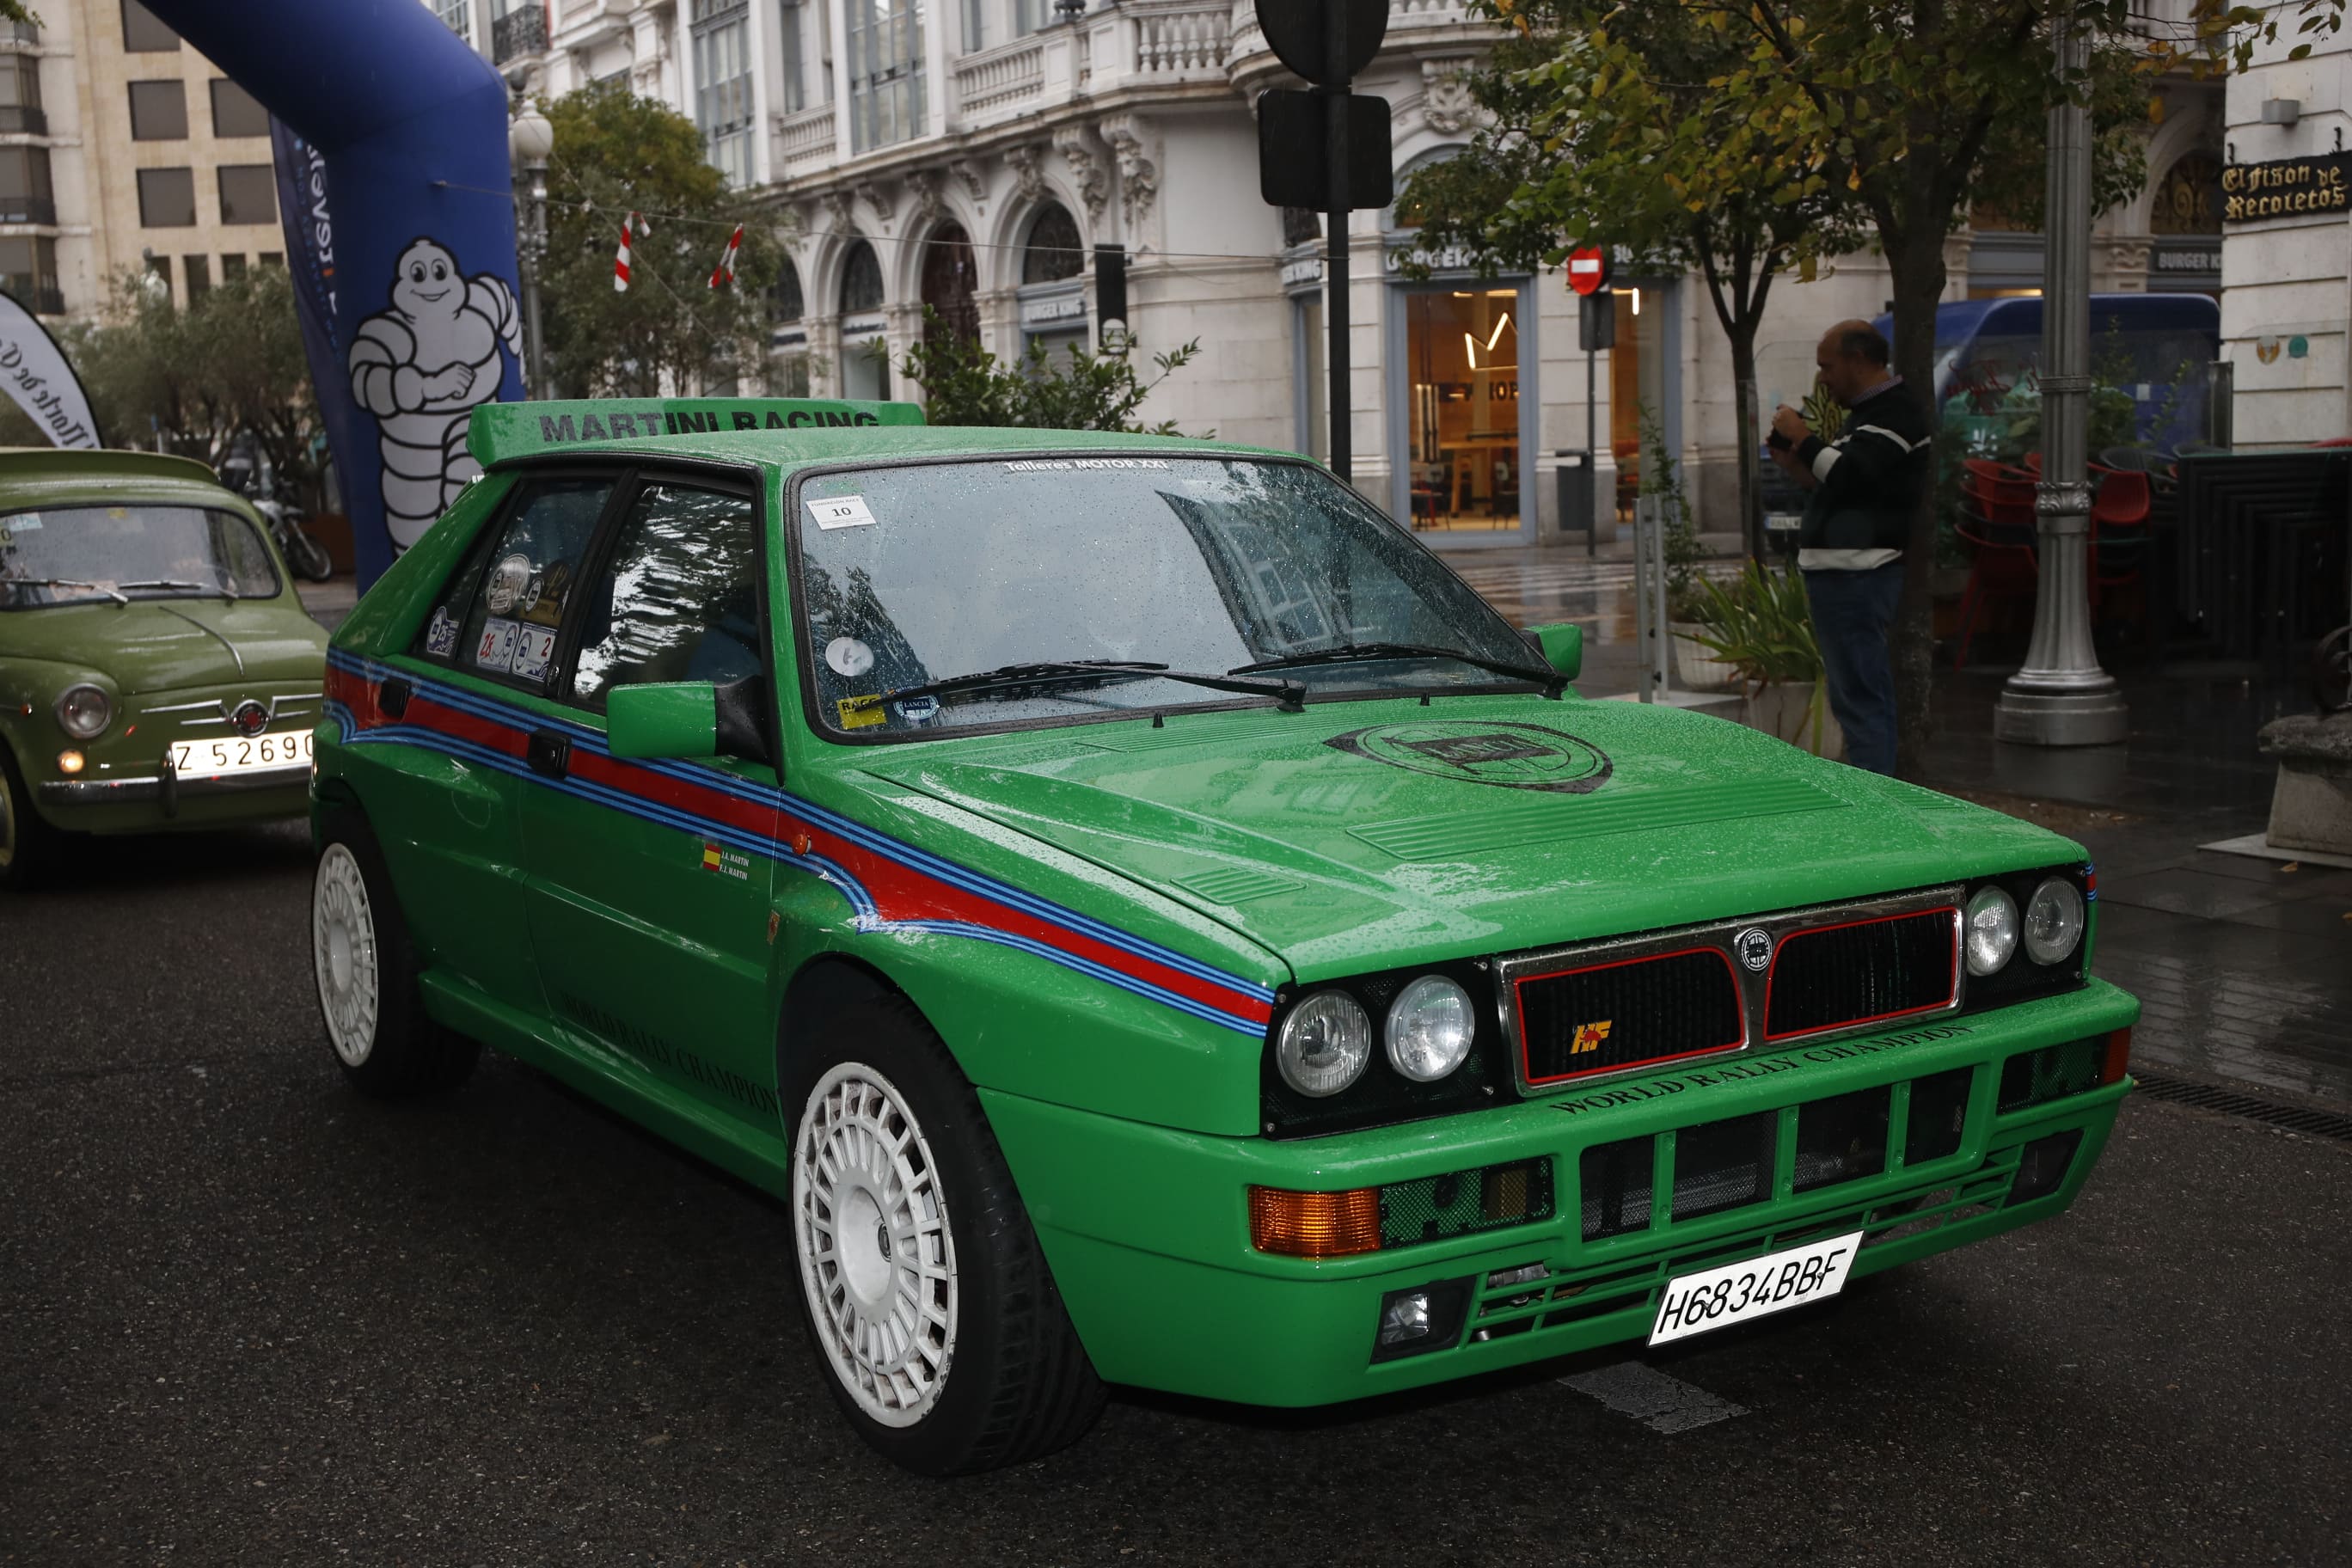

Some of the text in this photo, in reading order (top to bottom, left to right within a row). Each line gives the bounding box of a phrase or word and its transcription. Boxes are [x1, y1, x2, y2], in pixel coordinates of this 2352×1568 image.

[539, 411, 879, 443] MARTINI RACING
[1004, 460, 1073, 472] Talleres
[1075, 460, 1136, 469] MOTOR
[831, 507, 852, 517] 10
[541, 637, 551, 657] 2
[176, 746, 192, 770] Z
[1570, 1020, 1612, 1054] HF
[676, 1048, 779, 1115] CHAMPION
[1551, 1024, 1972, 1116] WORLD RALLY CHAMPION
[1657, 1248, 1847, 1334] H6834BBF
